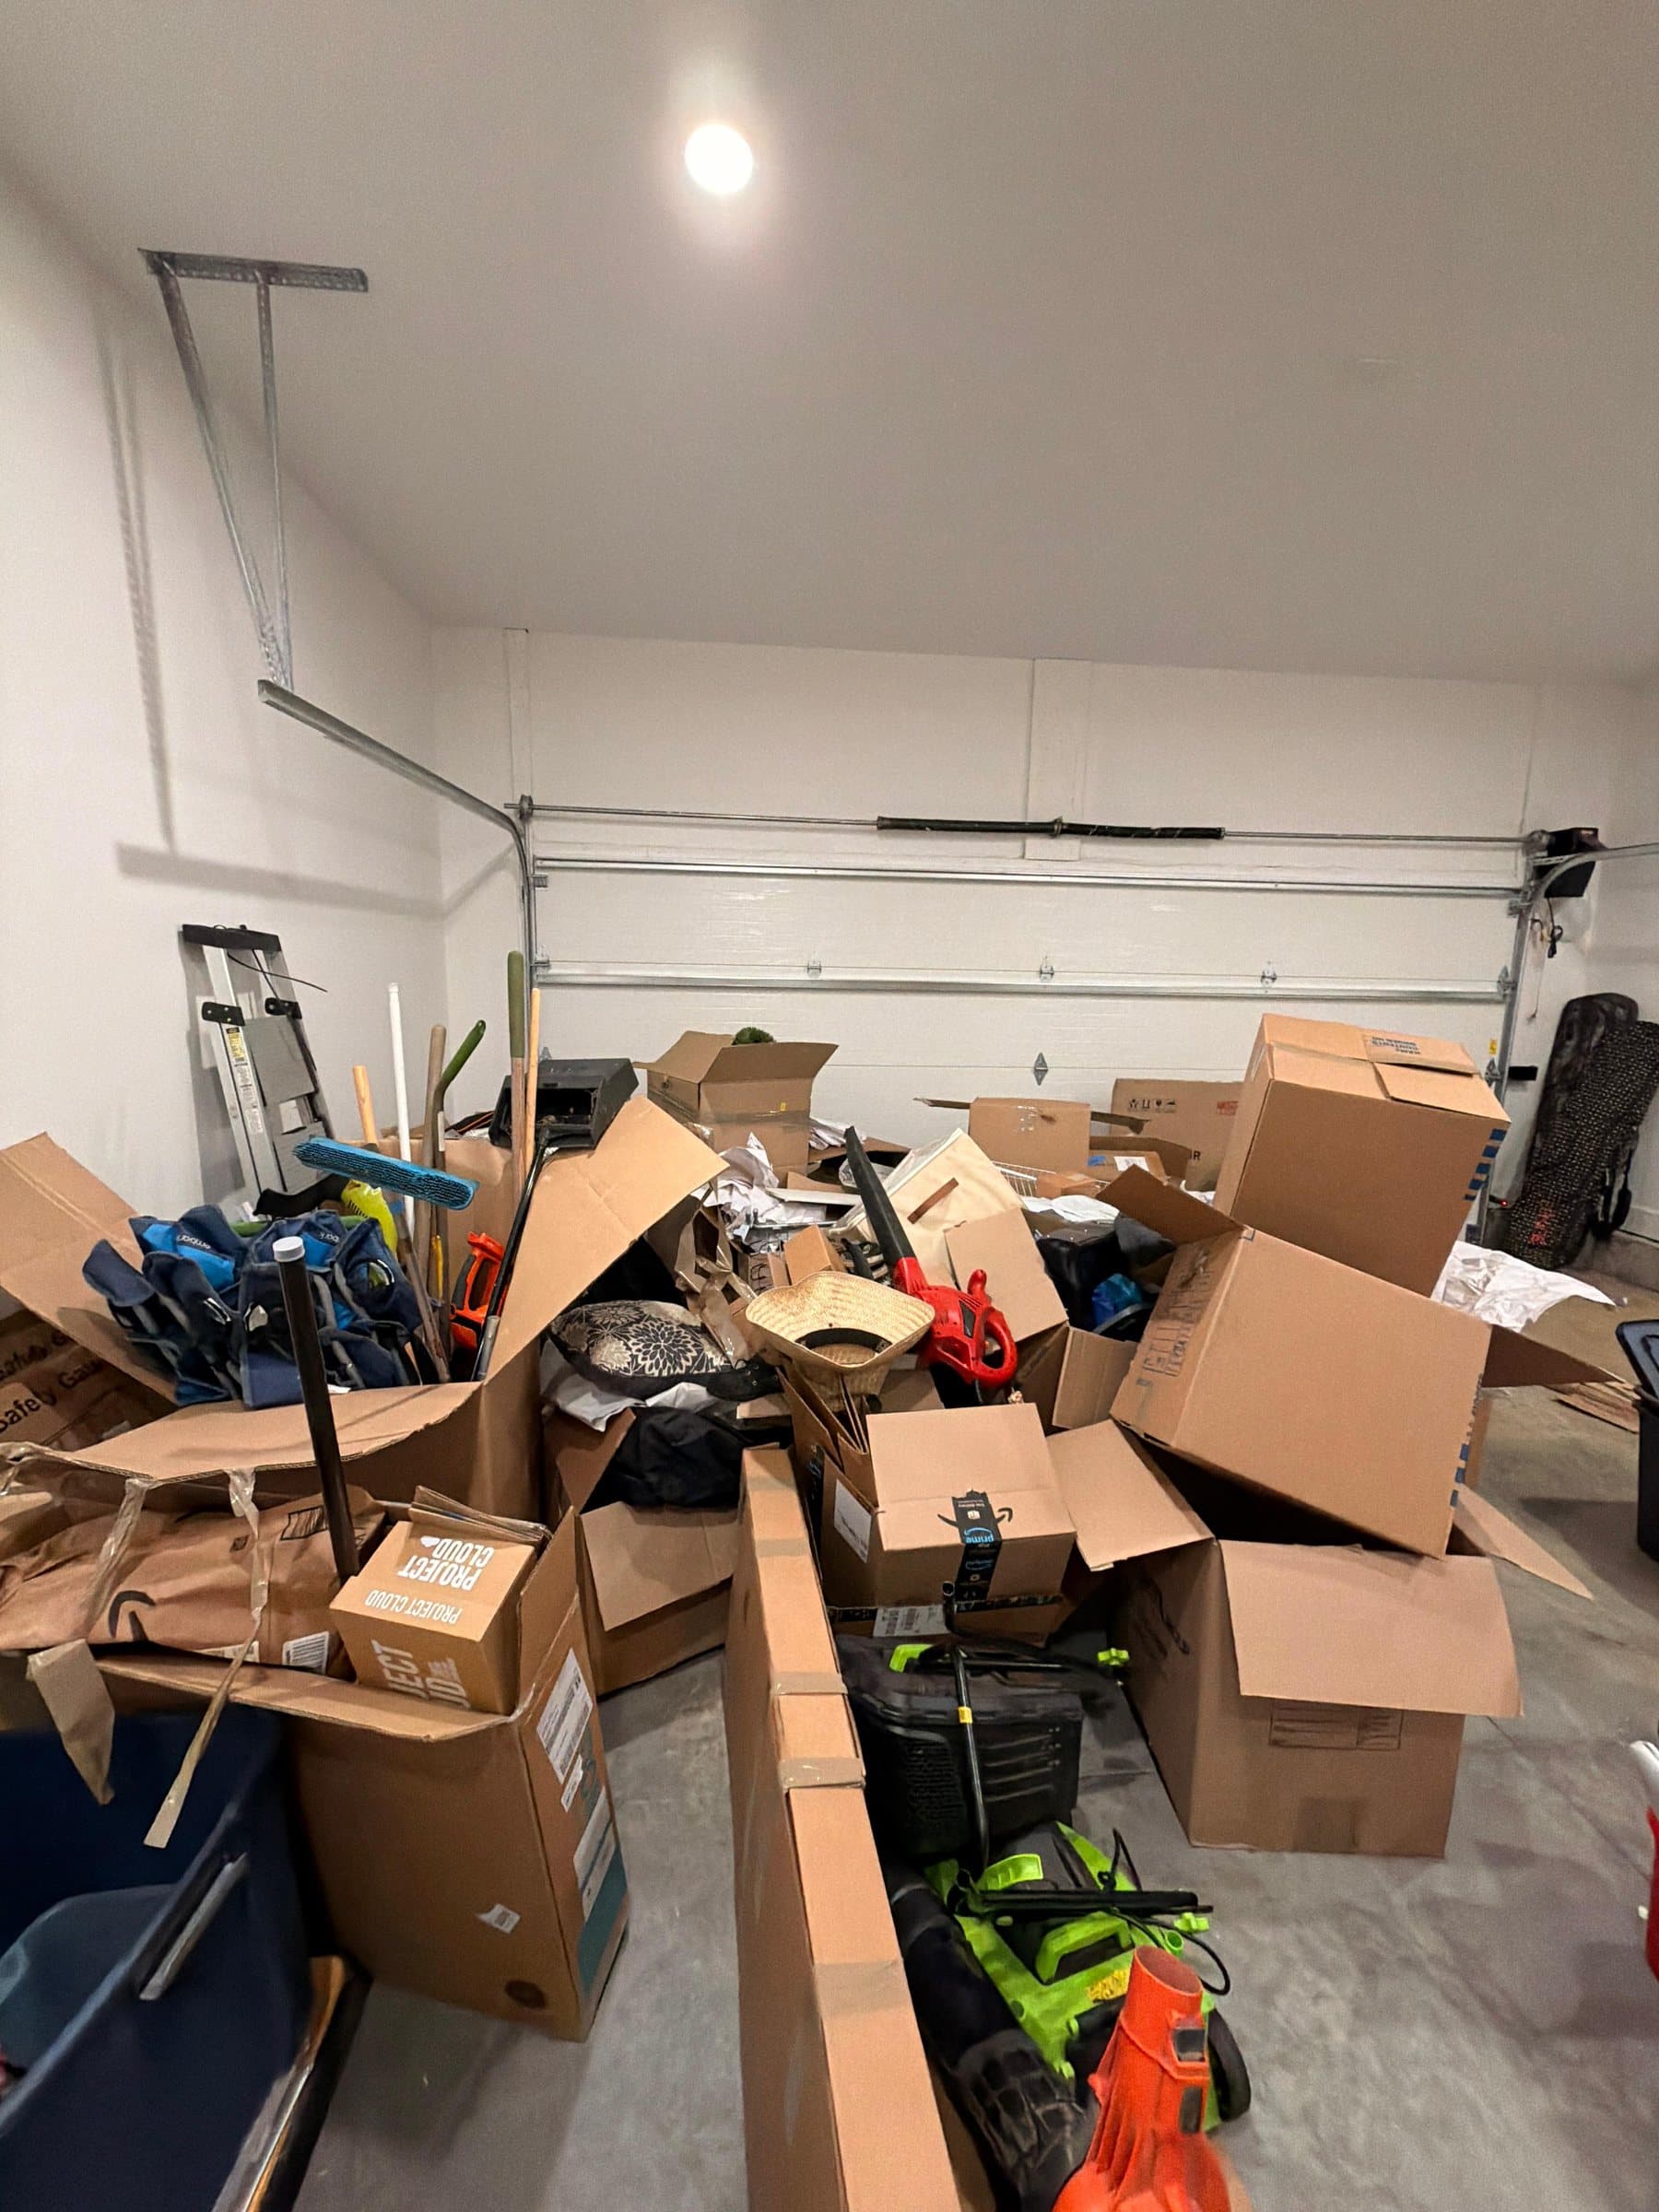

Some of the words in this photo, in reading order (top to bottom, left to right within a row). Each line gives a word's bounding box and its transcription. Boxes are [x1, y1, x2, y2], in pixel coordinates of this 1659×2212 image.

[965, 1533, 994, 1545] prime
[432, 1538, 495, 1567] CLOUD
[398, 1554, 482, 1591] PROJECT
[365, 1589, 408, 1612] CLOUD
[406, 1598, 462, 1624] PROJECT
